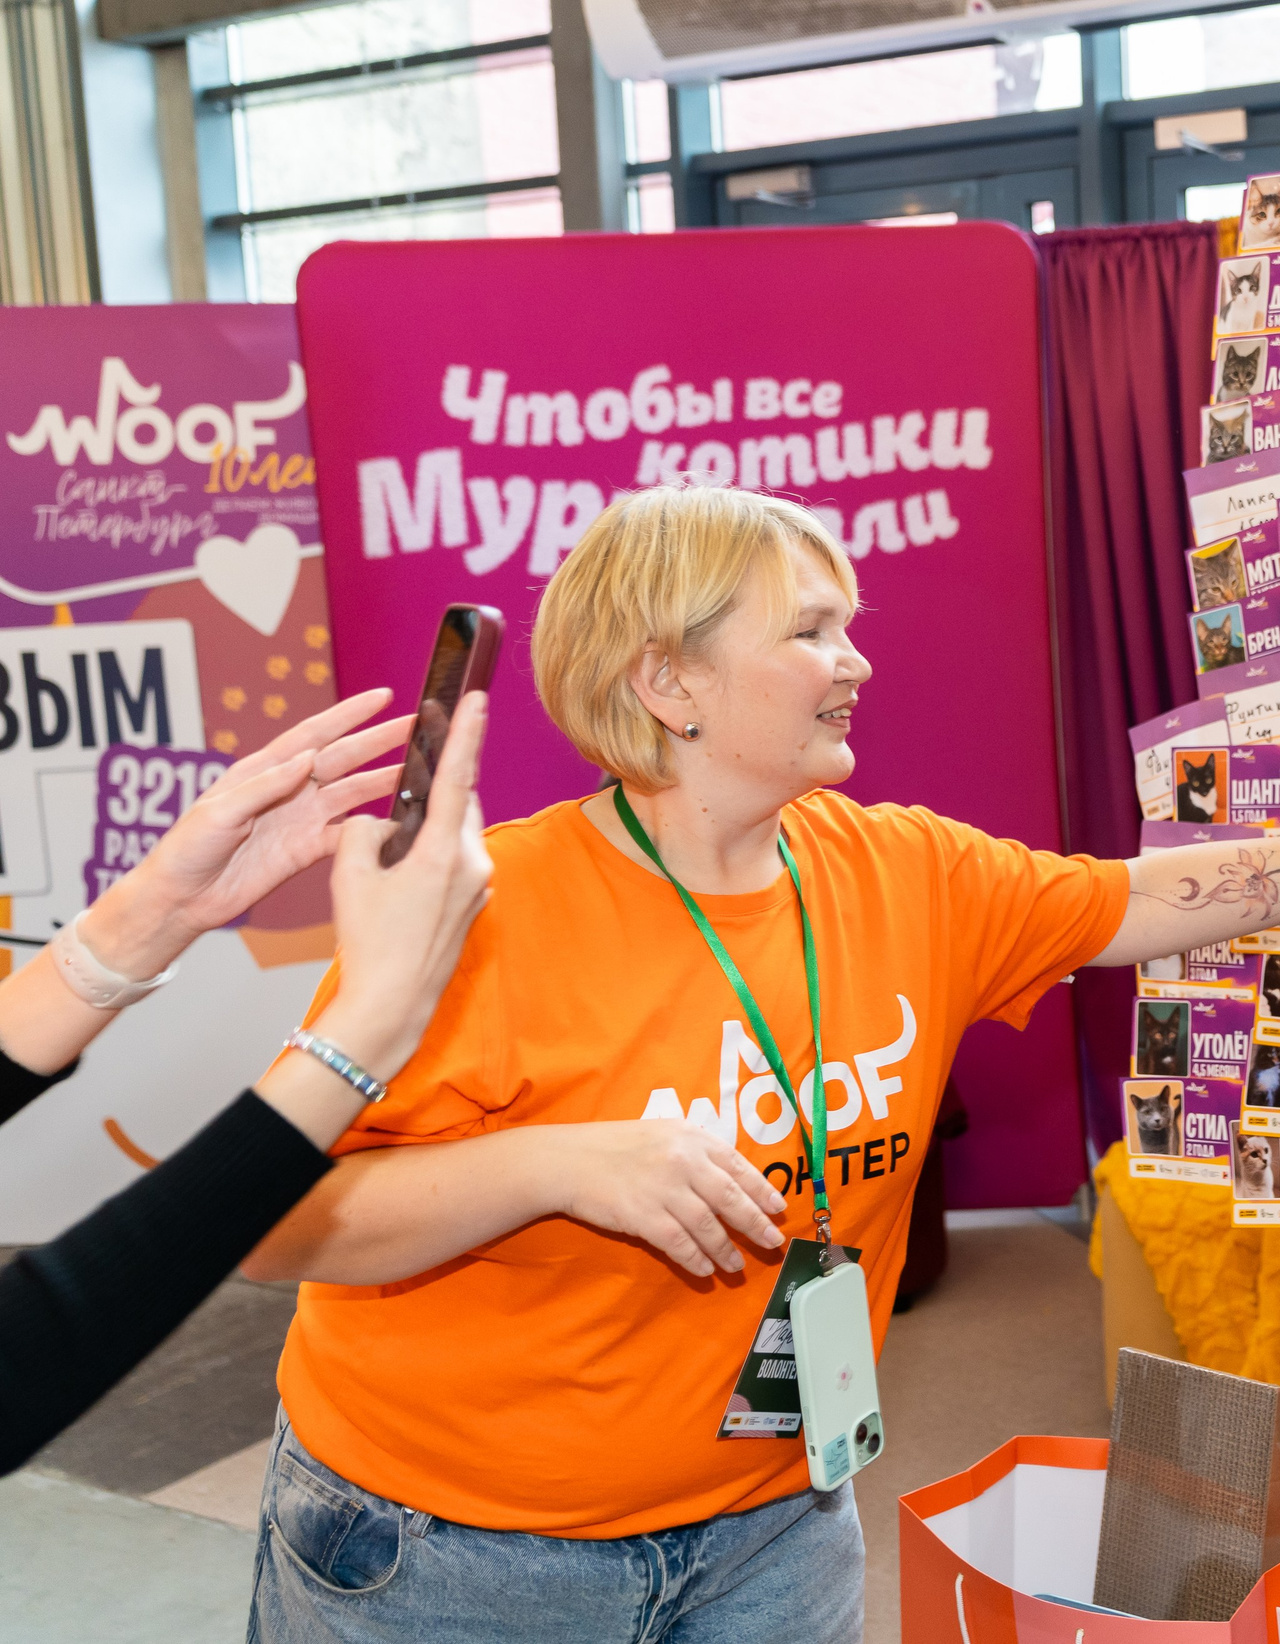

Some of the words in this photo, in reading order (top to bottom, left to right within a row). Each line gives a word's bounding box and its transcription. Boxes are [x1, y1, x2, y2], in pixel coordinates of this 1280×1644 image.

[6, 356, 308, 465] WOOF
[440, 363, 733, 446] Чтобы
[744, 378, 844, 421] все
[636, 408, 992, 491] котики
[640, 995, 917, 1149] WOOF
[1186, 1114, 1228, 1141] СТИЛ
[757, 1359, 797, 1379] ВОЛОНТЕ
